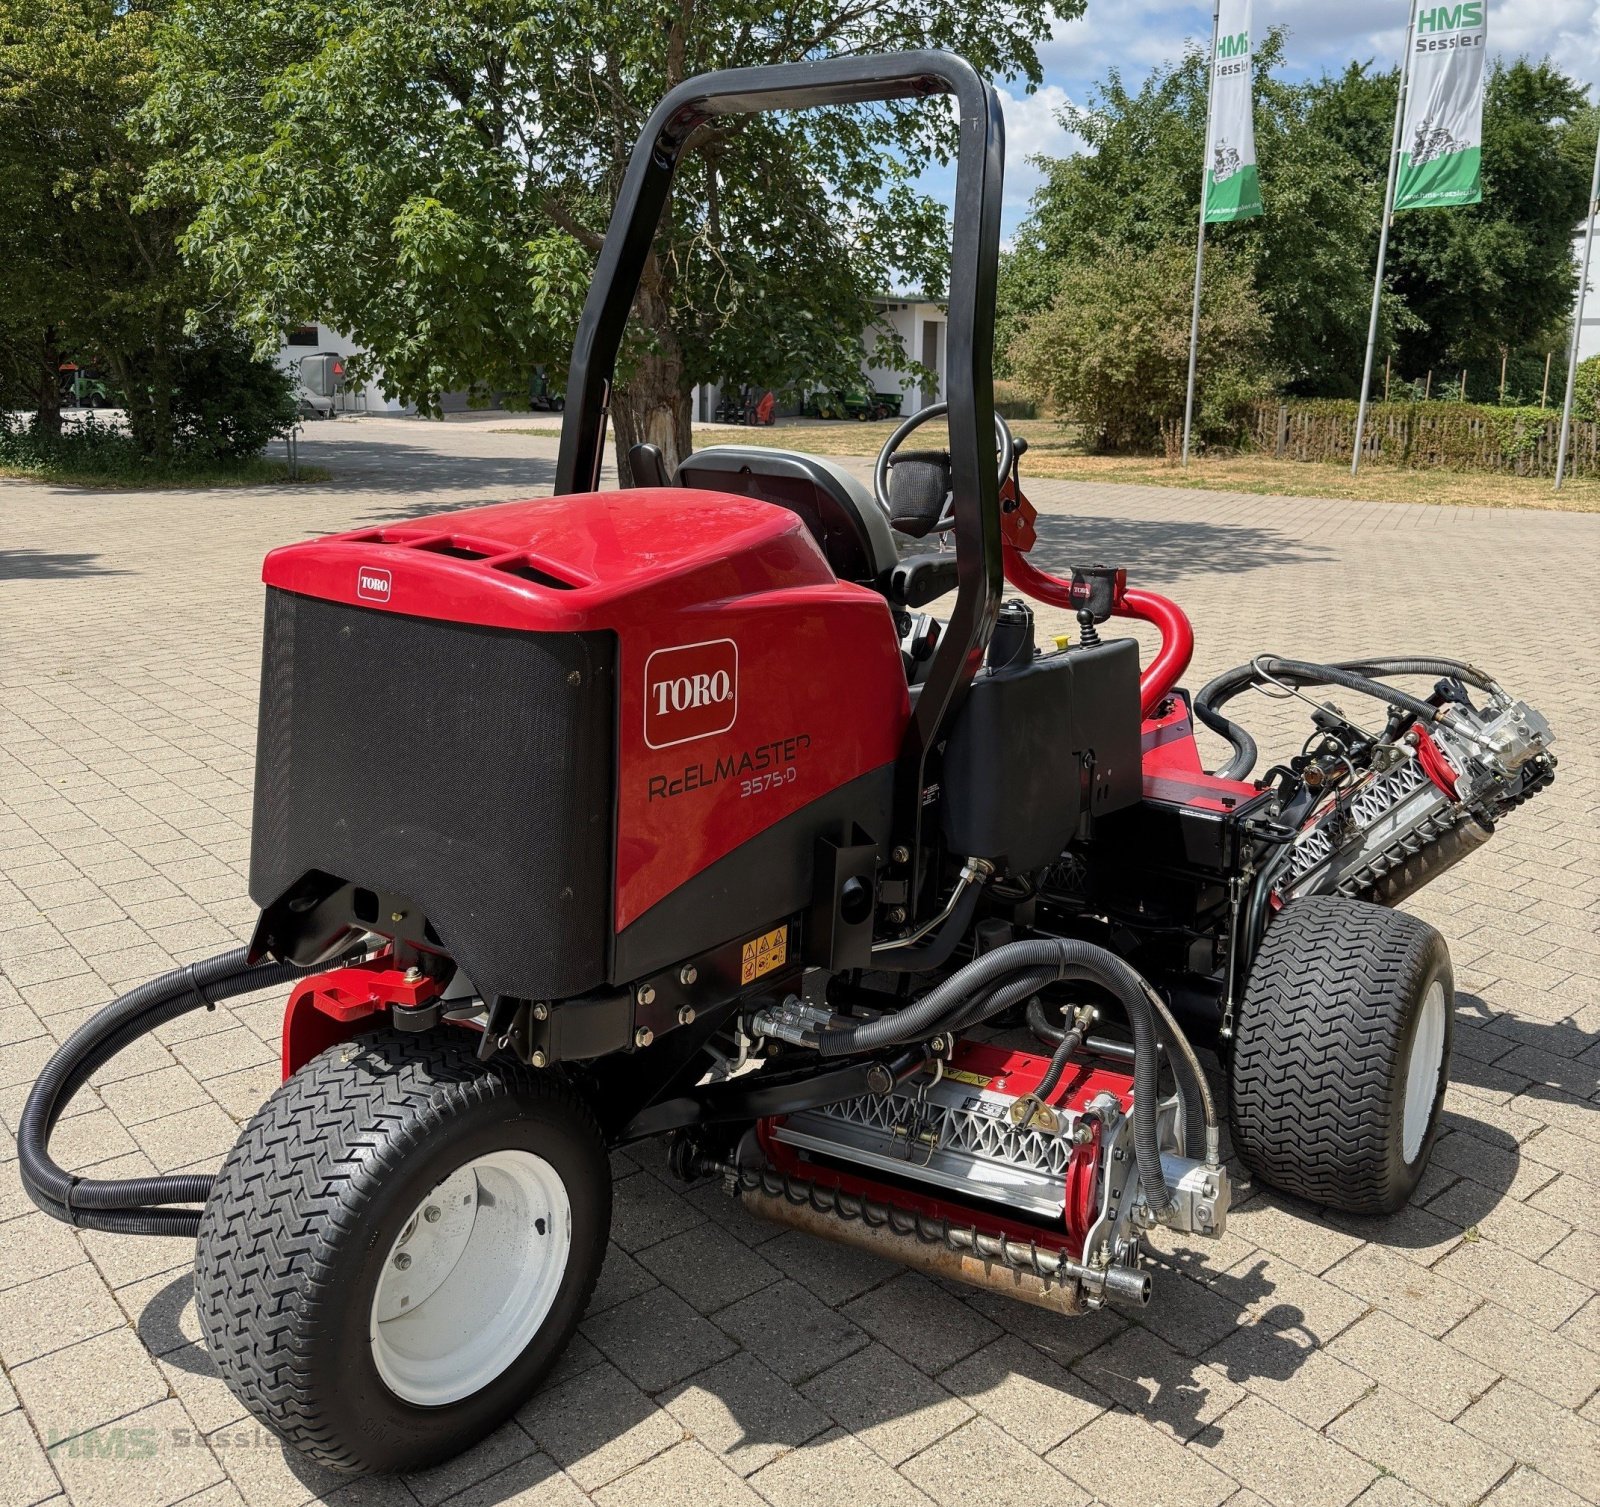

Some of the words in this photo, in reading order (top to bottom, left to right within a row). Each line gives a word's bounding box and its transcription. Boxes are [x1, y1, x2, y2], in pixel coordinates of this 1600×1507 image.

[1417, 2, 1483, 33] HMS
[1415, 34, 1482, 52] Sessler
[361, 576, 388, 592] TORO
[653, 669, 731, 716] TORO
